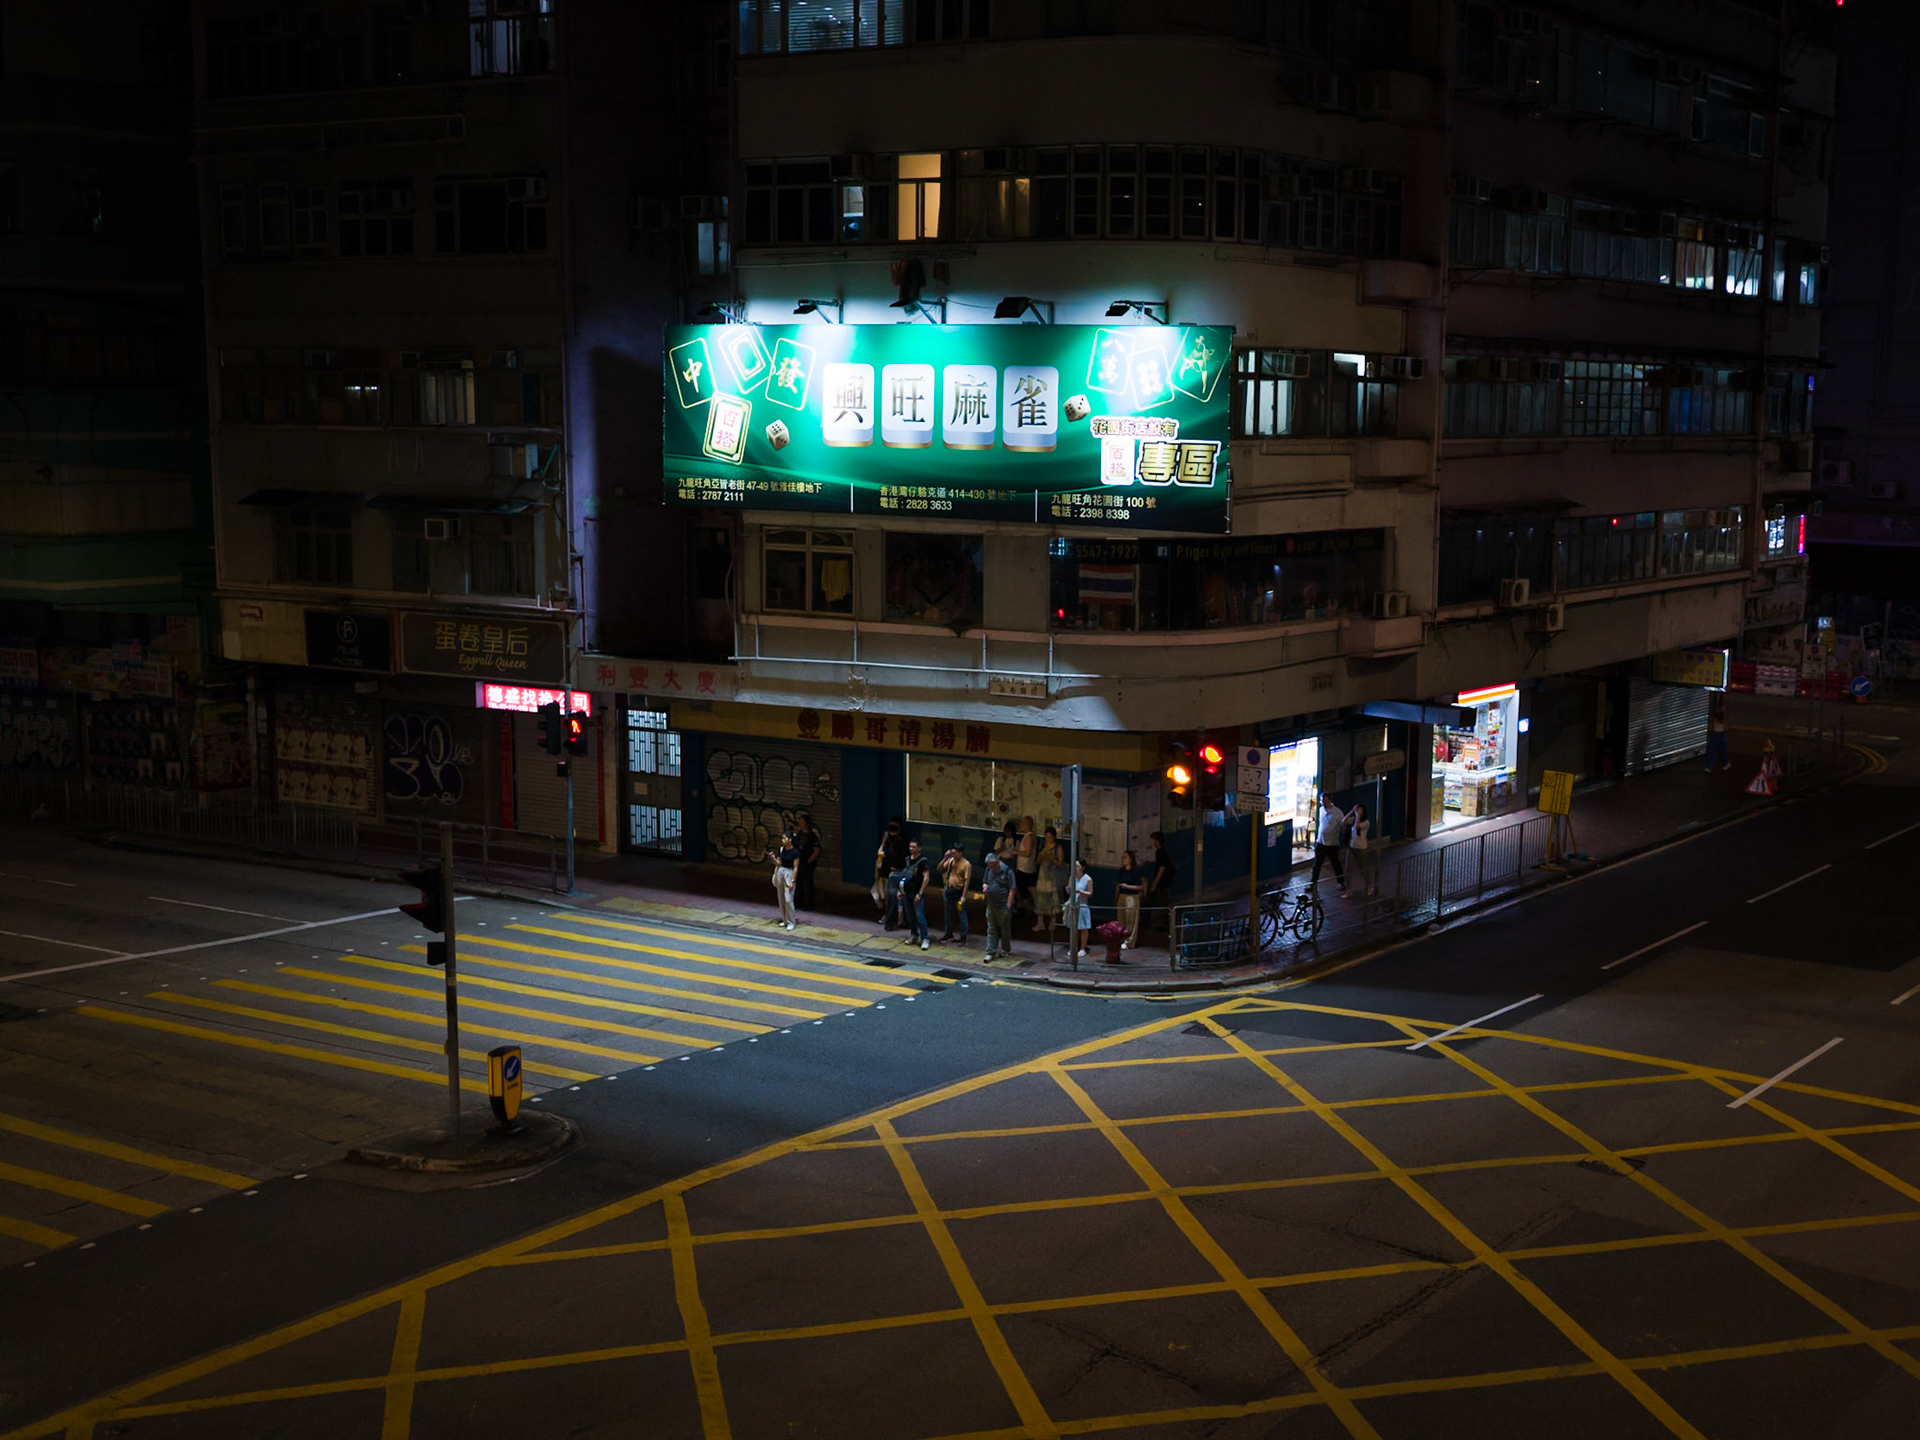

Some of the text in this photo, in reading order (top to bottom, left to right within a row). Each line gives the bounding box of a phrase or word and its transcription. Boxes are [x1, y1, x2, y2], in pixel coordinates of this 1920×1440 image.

[682, 357, 704, 394] 中
[1140, 440, 1218, 485] 專區
[746, 480, 769, 491] 47-49
[702, 490, 722, 501] 2787
[724, 491, 744, 502] 2111
[948, 488, 985, 500] 414-430
[906, 499, 928, 510] 2828
[930, 500, 953, 511] 3633
[1126, 496, 1144, 508] 100
[1079, 508, 1104, 519] 2398
[1106, 509, 1130, 520] 8398
[434, 620, 530, 656] 蛋卷皇后
[458, 653, 529, 672] Eggroll Queen
